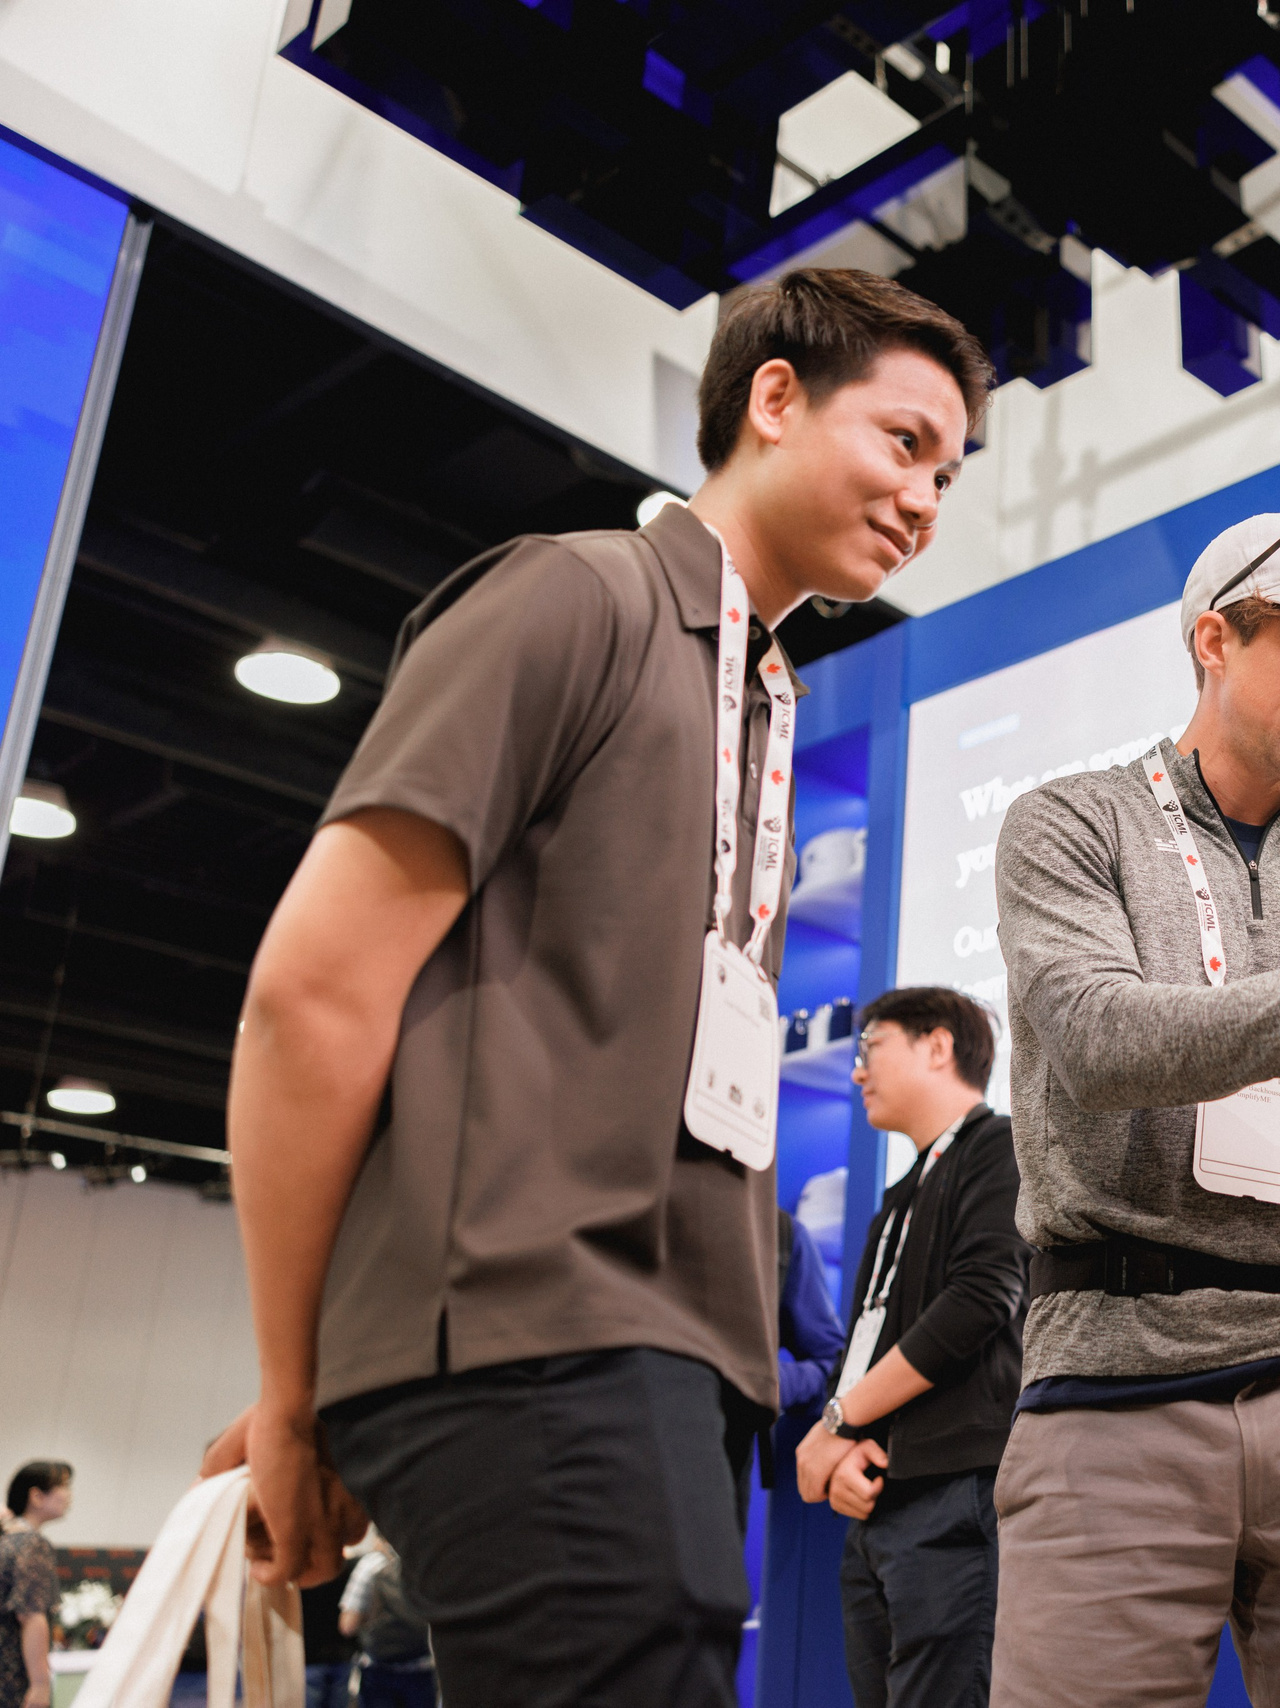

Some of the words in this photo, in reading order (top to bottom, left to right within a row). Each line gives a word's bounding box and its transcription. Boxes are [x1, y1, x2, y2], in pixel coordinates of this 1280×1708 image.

[724, 656, 735, 689] ICML
[779, 708, 790, 739] ICML
[1172, 814, 1188, 836] ICML
[764, 836, 779, 871] ICML
[1204, 902, 1216, 932] ICML
